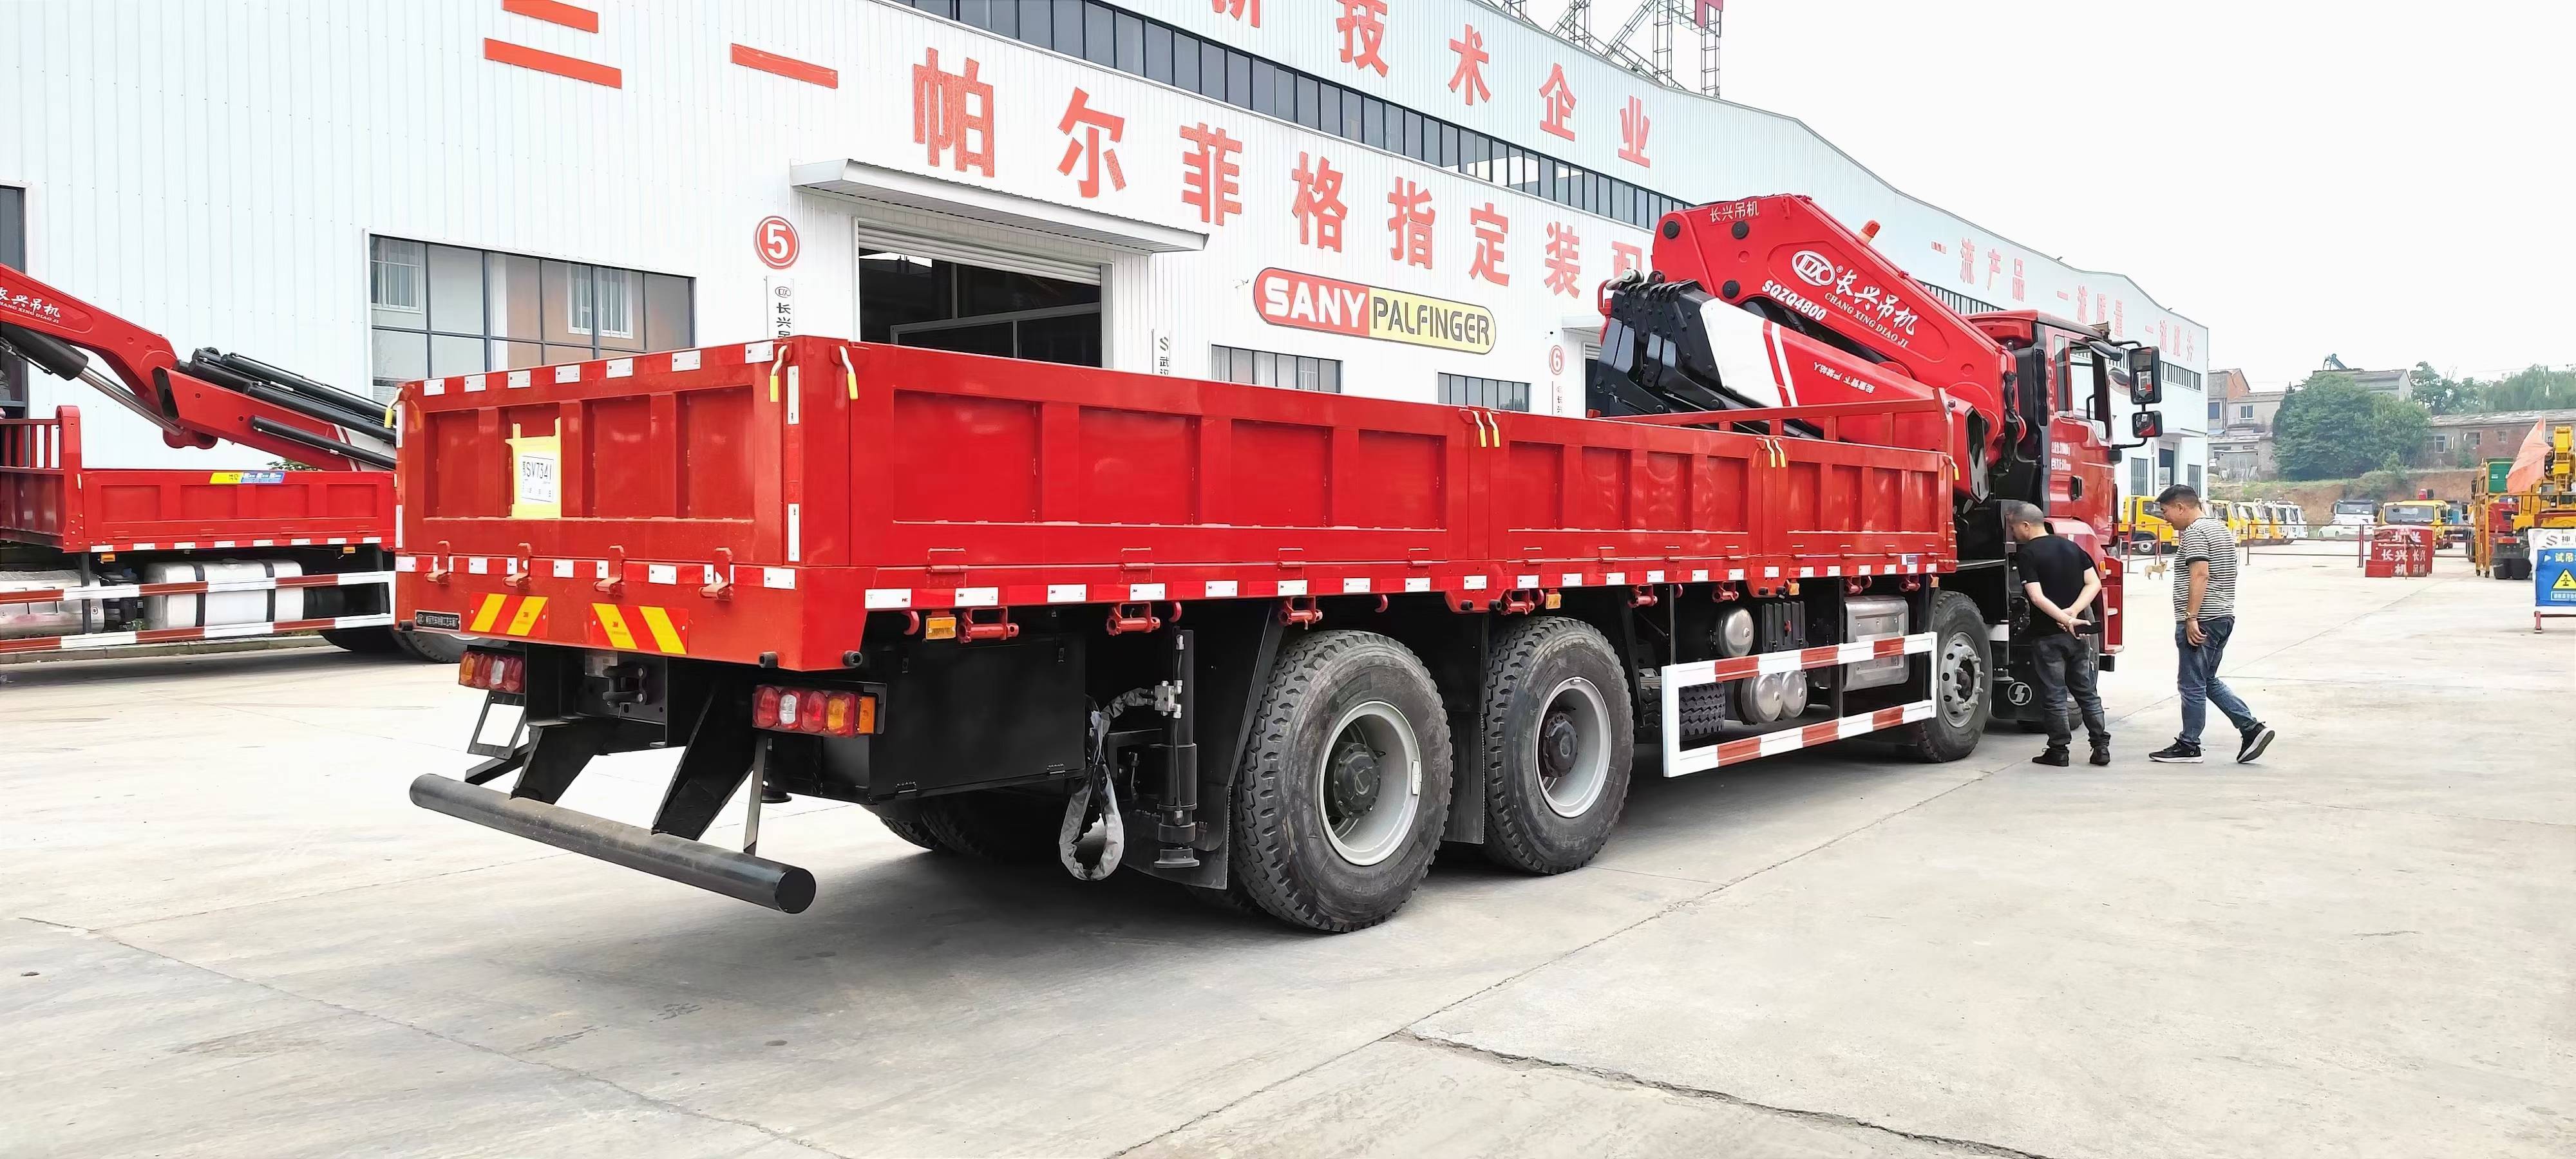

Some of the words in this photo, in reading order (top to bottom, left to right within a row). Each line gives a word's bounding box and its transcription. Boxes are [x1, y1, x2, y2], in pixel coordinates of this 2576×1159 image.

[1710, 200, 1759, 223] 长兴吊机
[767, 223, 789, 259] 5
[1931, 236, 2025, 303] 一流产品
[1264, 276, 1366, 328] SANY
[1374, 296, 1490, 346] PALFINGER
[1761, 279, 1827, 321] SQZQ4800
[1824, 292, 1855, 315] CHANG
[1854, 310, 1877, 328] XING
[1875, 323, 1899, 342] DIAO
[1897, 337, 1909, 348] JI
[1835, 269, 1918, 335] 长兴吊机
[2382, 549, 2409, 561] 长兴
[2555, 552, 2576, 563] 试吊
